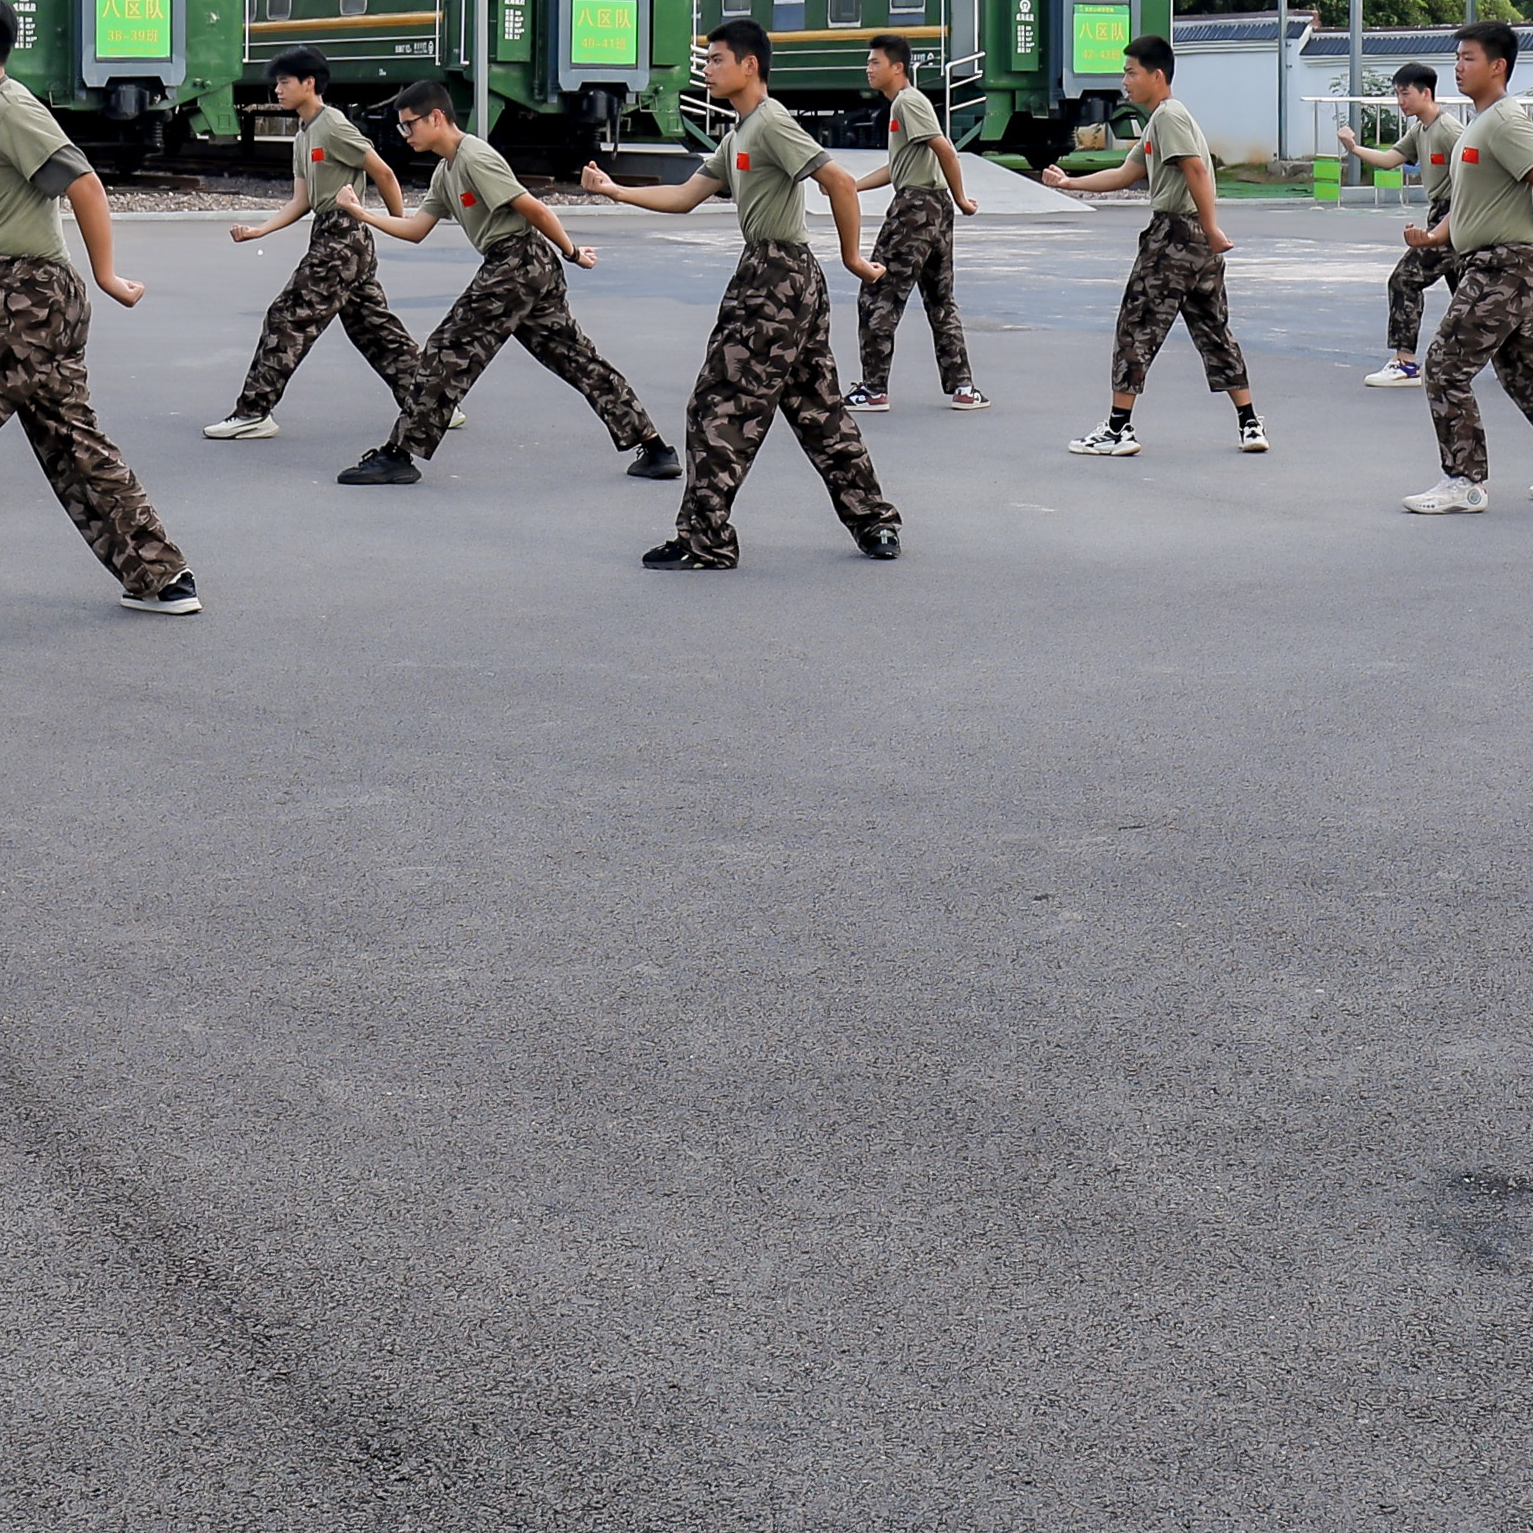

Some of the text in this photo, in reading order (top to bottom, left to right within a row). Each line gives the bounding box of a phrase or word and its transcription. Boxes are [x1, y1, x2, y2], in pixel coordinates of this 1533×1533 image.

[578, 8, 633, 29] 八区队
[1079, 22, 1126, 42] 八区队
